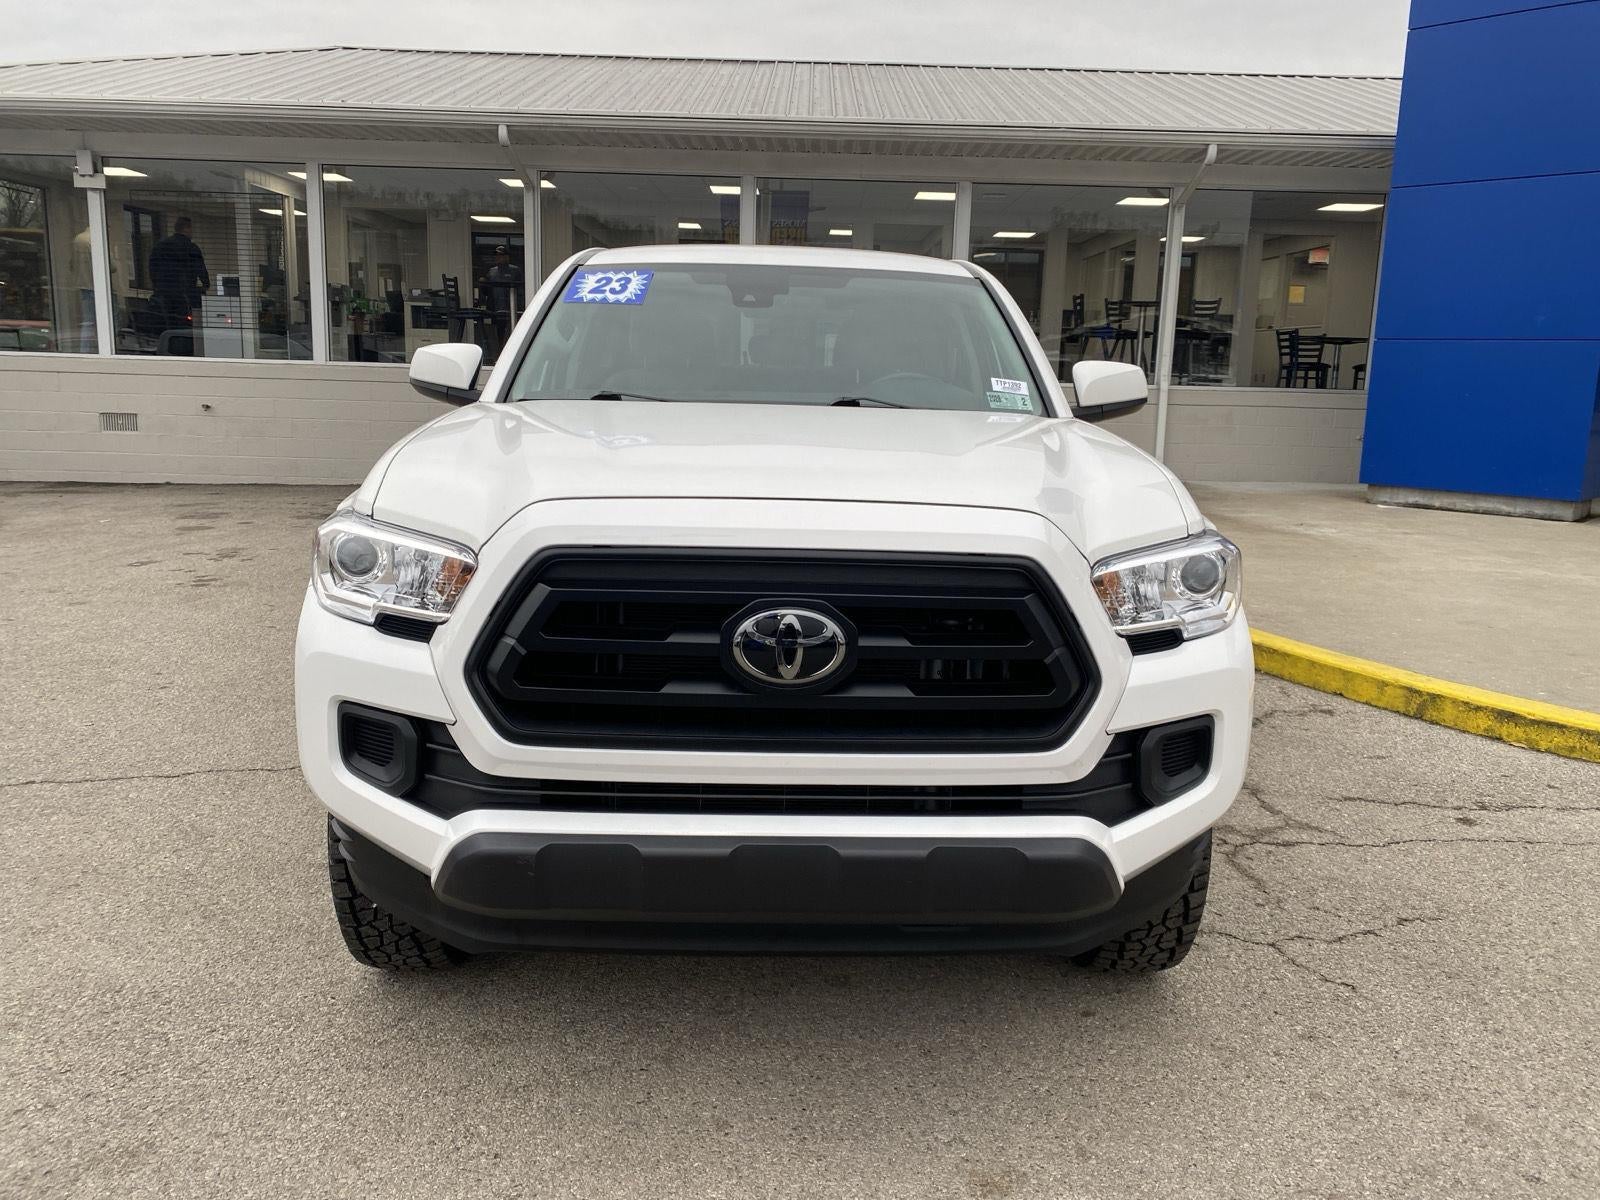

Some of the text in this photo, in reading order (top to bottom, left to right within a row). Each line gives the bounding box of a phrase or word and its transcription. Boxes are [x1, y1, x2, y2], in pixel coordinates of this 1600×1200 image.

[587, 276, 633, 295] 23
[995, 379, 1022, 389] TTP1392
[1021, 397, 1028, 406] 2
